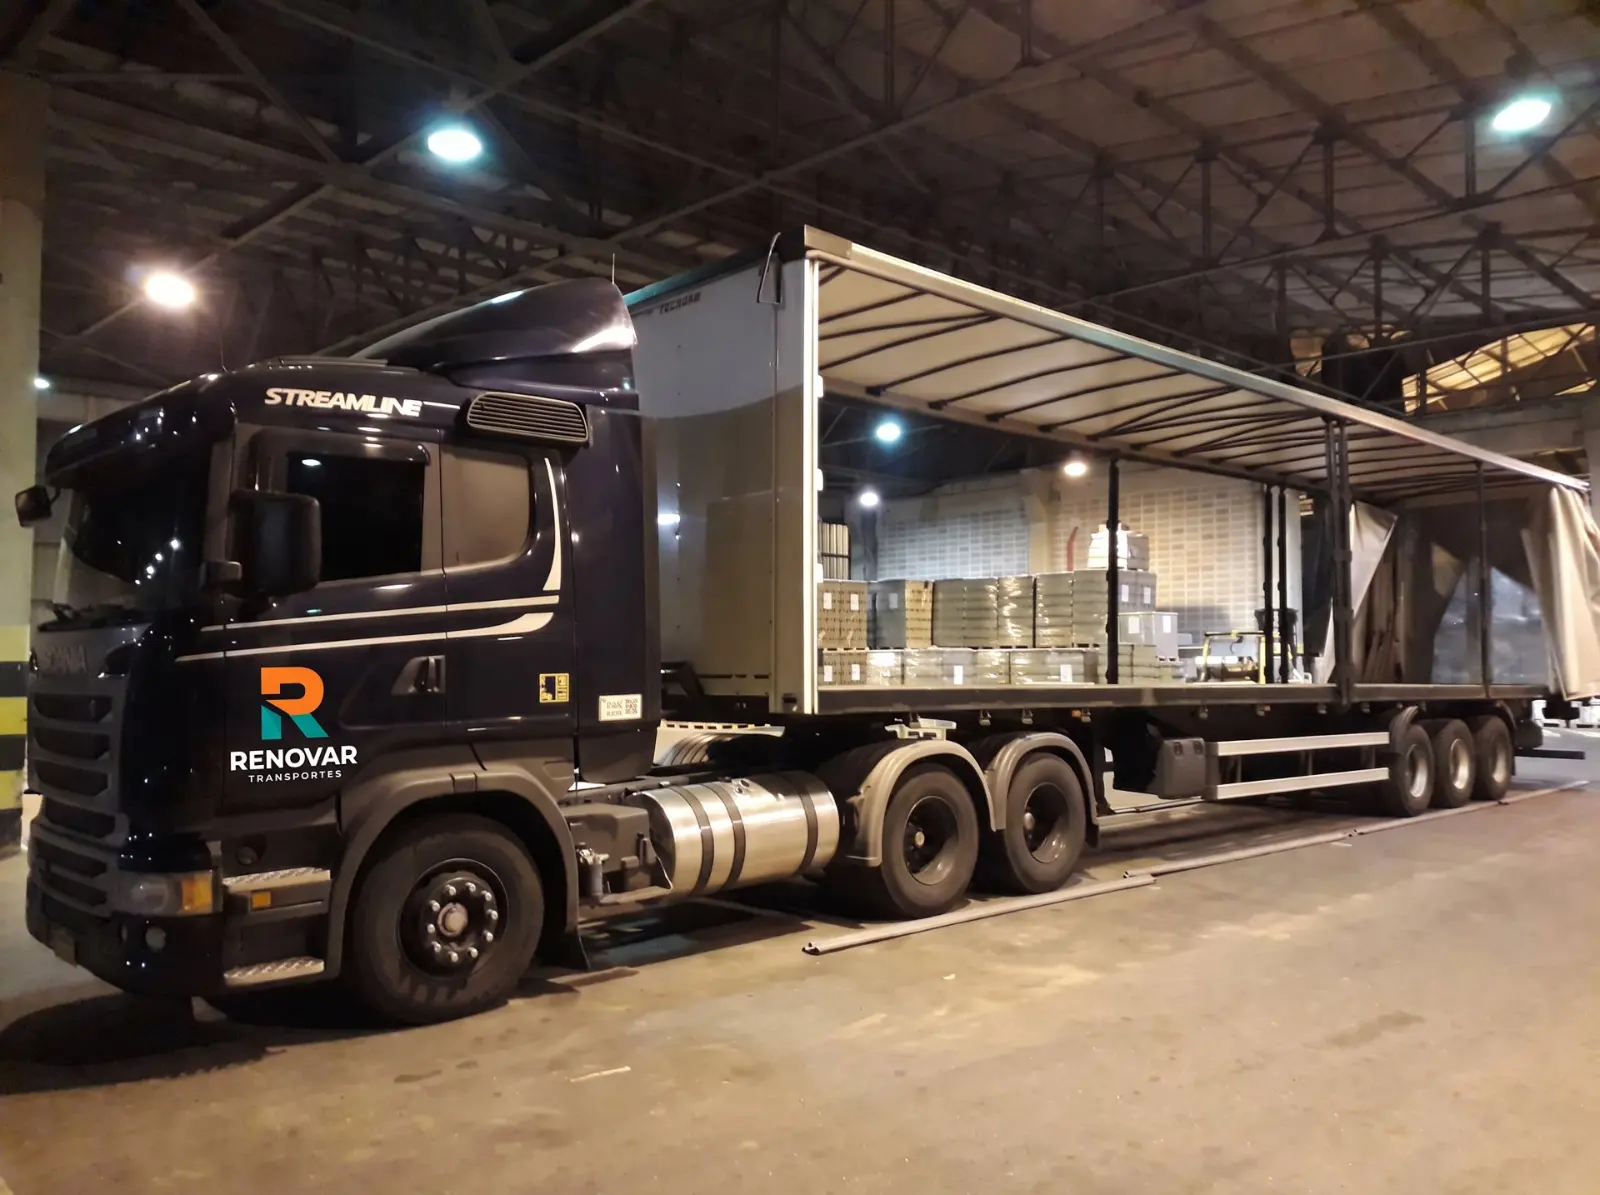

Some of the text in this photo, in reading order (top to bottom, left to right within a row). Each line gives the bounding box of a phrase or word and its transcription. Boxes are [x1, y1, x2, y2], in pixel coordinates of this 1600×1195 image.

[264, 387, 423, 417] STREAMLINE
[230, 745, 358, 771] RENOVAR
[248, 770, 342, 783] TRANSPORTES
